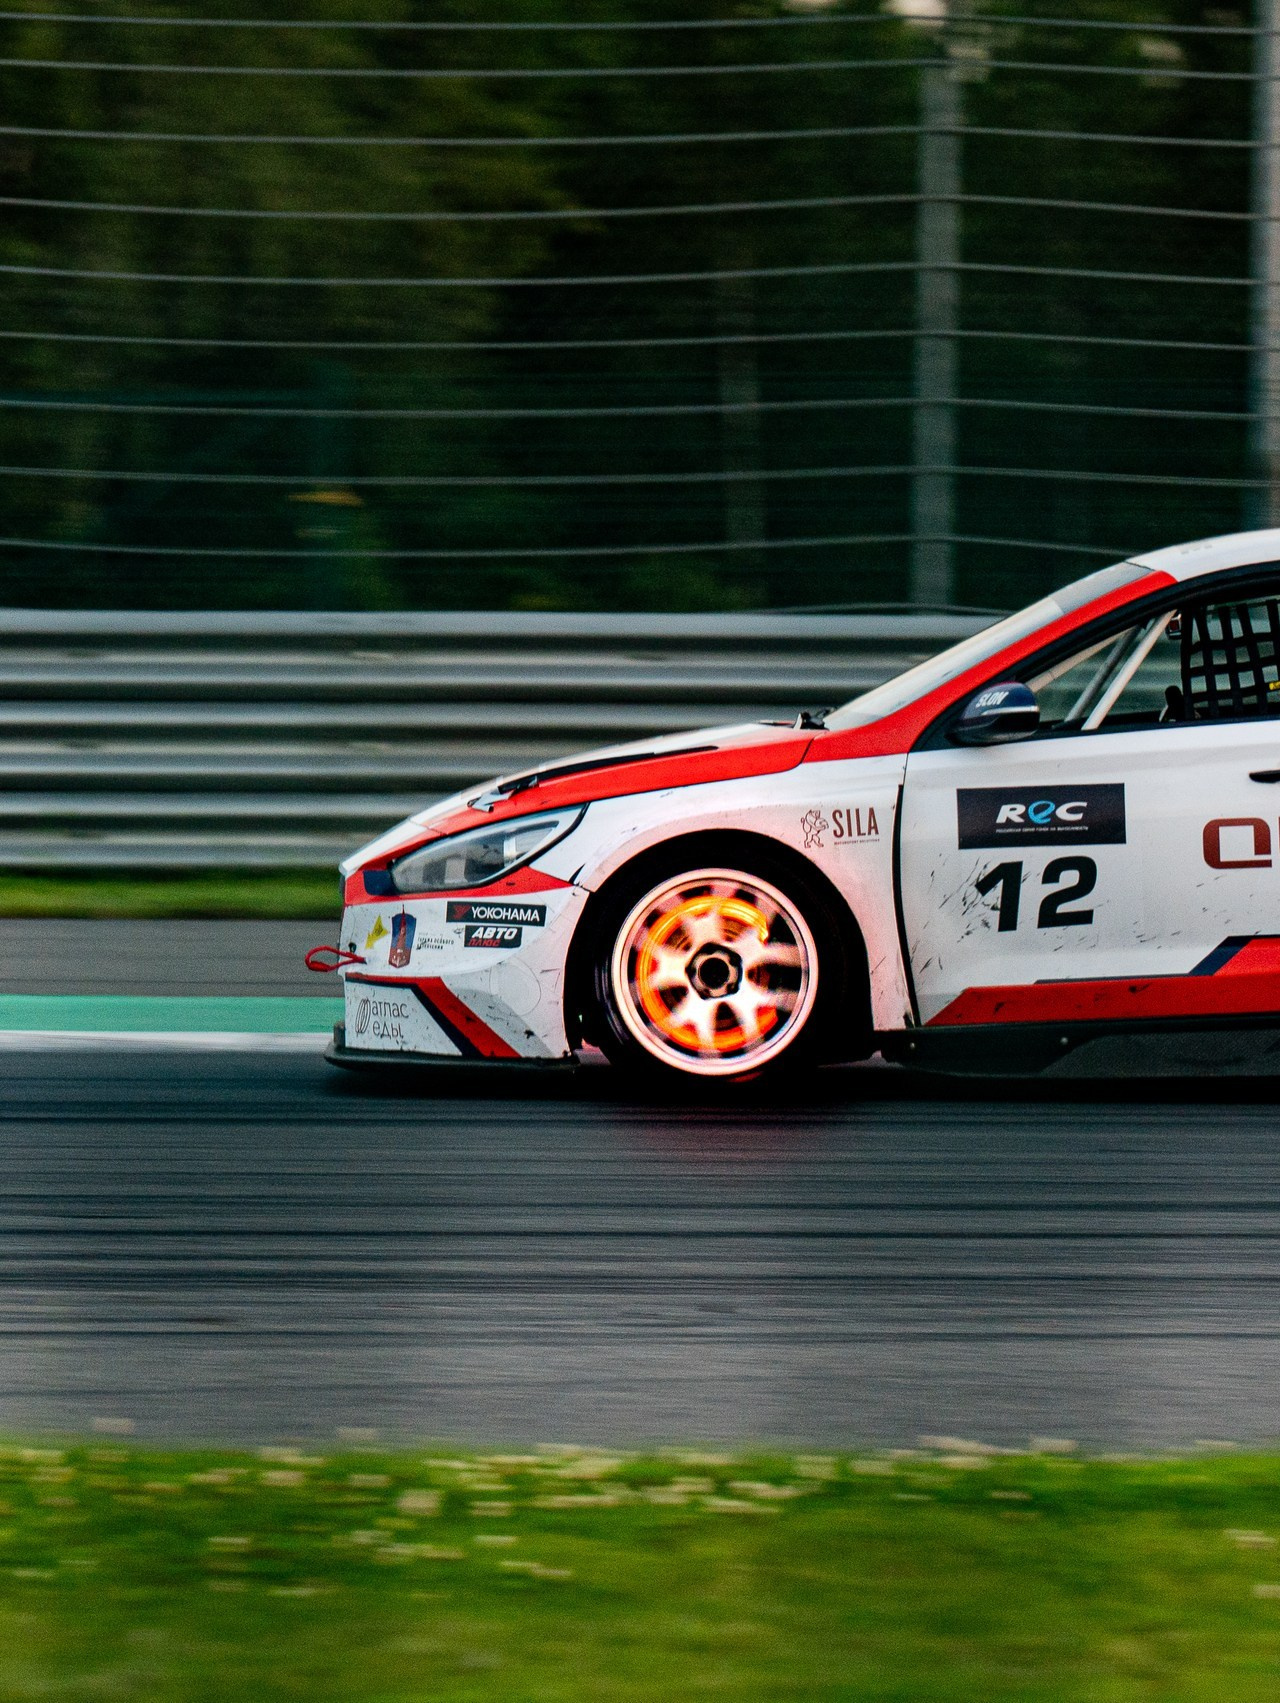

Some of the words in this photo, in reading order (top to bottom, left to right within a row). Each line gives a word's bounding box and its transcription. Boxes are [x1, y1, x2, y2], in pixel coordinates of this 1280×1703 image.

[831, 806, 879, 839] SILA
[974, 855, 1098, 932] 12
[471, 906, 540, 922] YOKOHAMA
[468, 937, 501, 947] ПЛЮС
[471, 926, 518, 940] АВТО
[371, 1000, 409, 1018] атлас
[372, 1020, 404, 1039] еды
